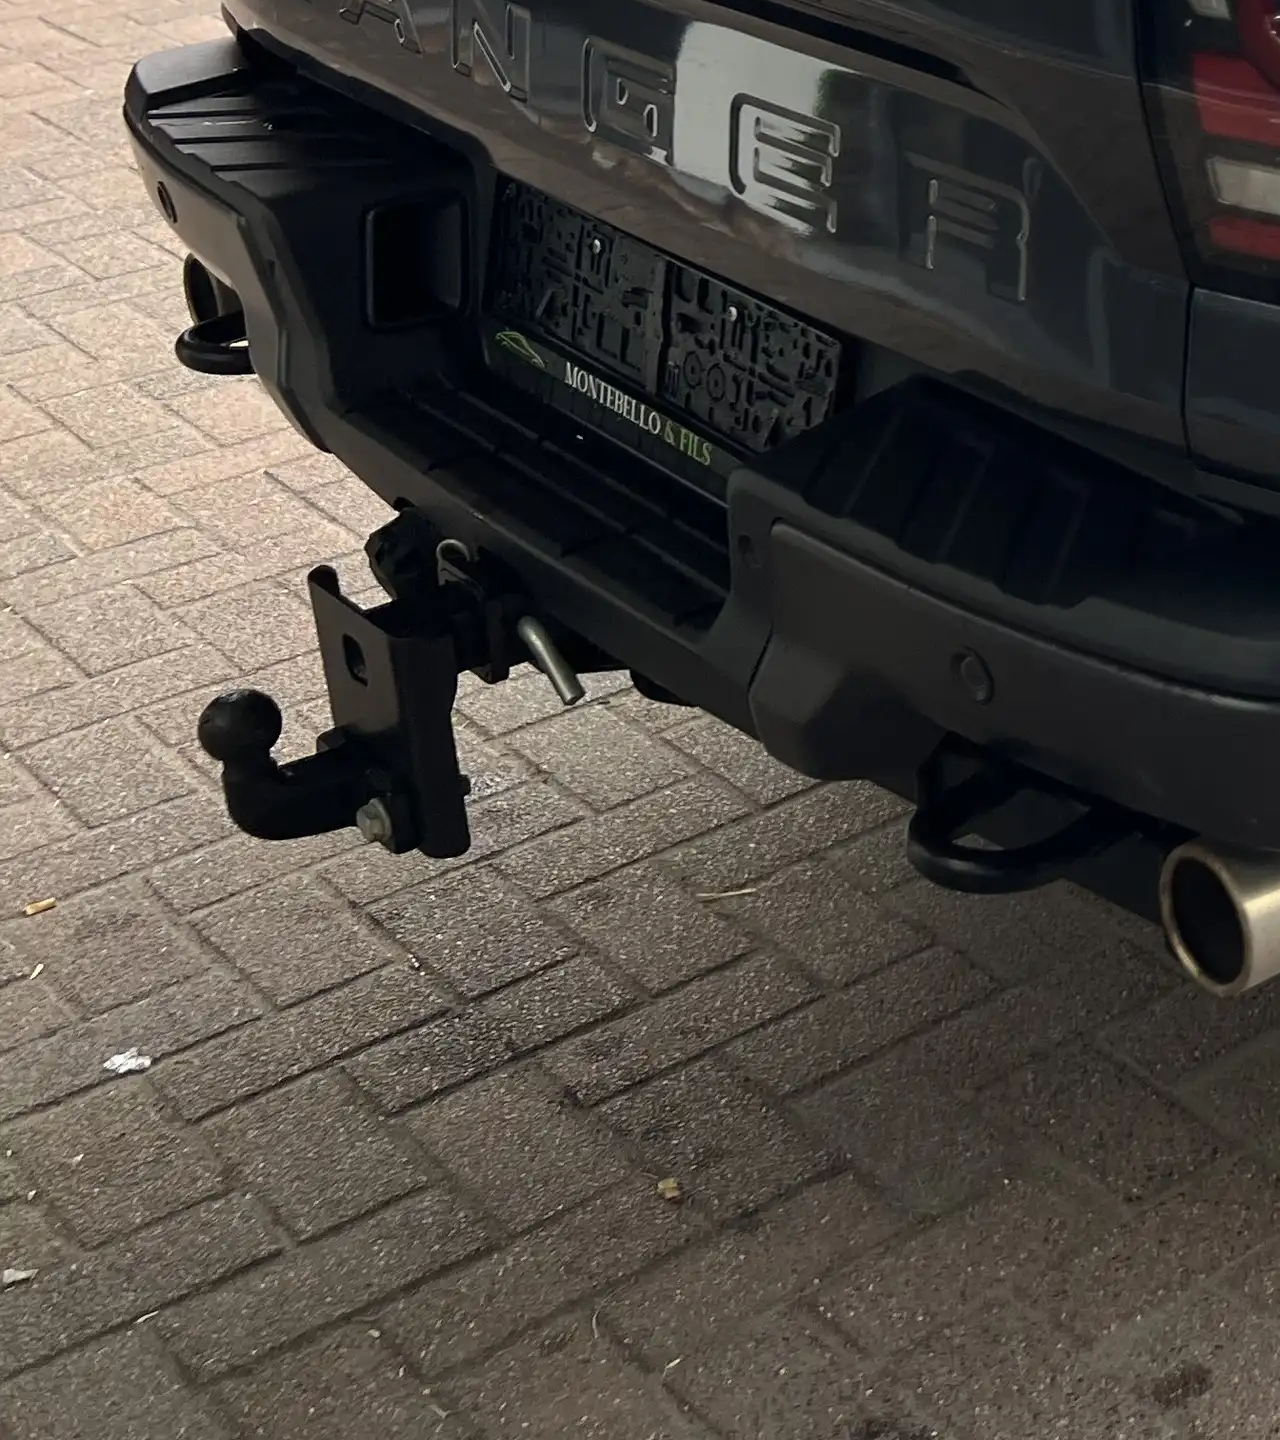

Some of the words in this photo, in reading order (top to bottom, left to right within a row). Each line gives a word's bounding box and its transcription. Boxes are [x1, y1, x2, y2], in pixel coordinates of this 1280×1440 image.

[564, 361, 661, 435] MONTEBELLO
[664, 420, 676, 446] &
[679, 427, 713, 466] FILS
